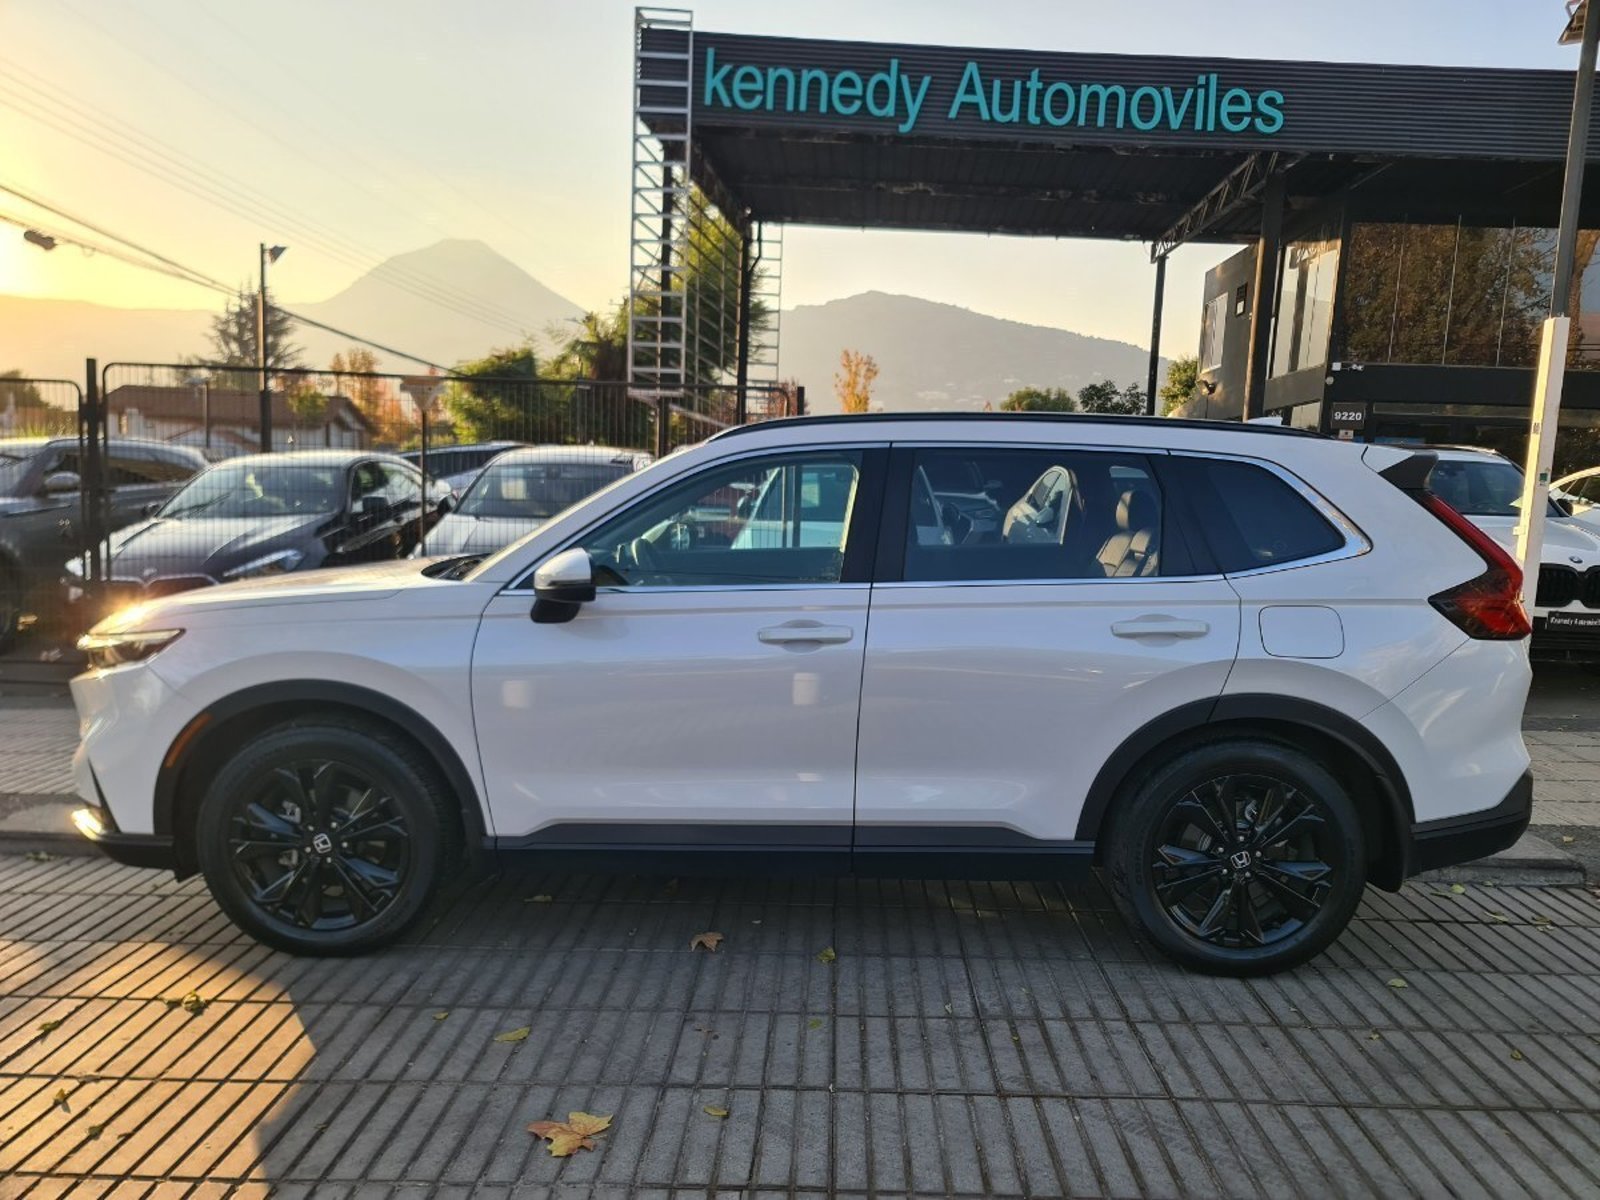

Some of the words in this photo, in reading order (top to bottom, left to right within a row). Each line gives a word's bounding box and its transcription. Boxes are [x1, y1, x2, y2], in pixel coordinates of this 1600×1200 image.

[704, 48, 931, 133] kennedy
[948, 61, 1284, 134] Automoviles
[1334, 411, 1362, 421] 9220
